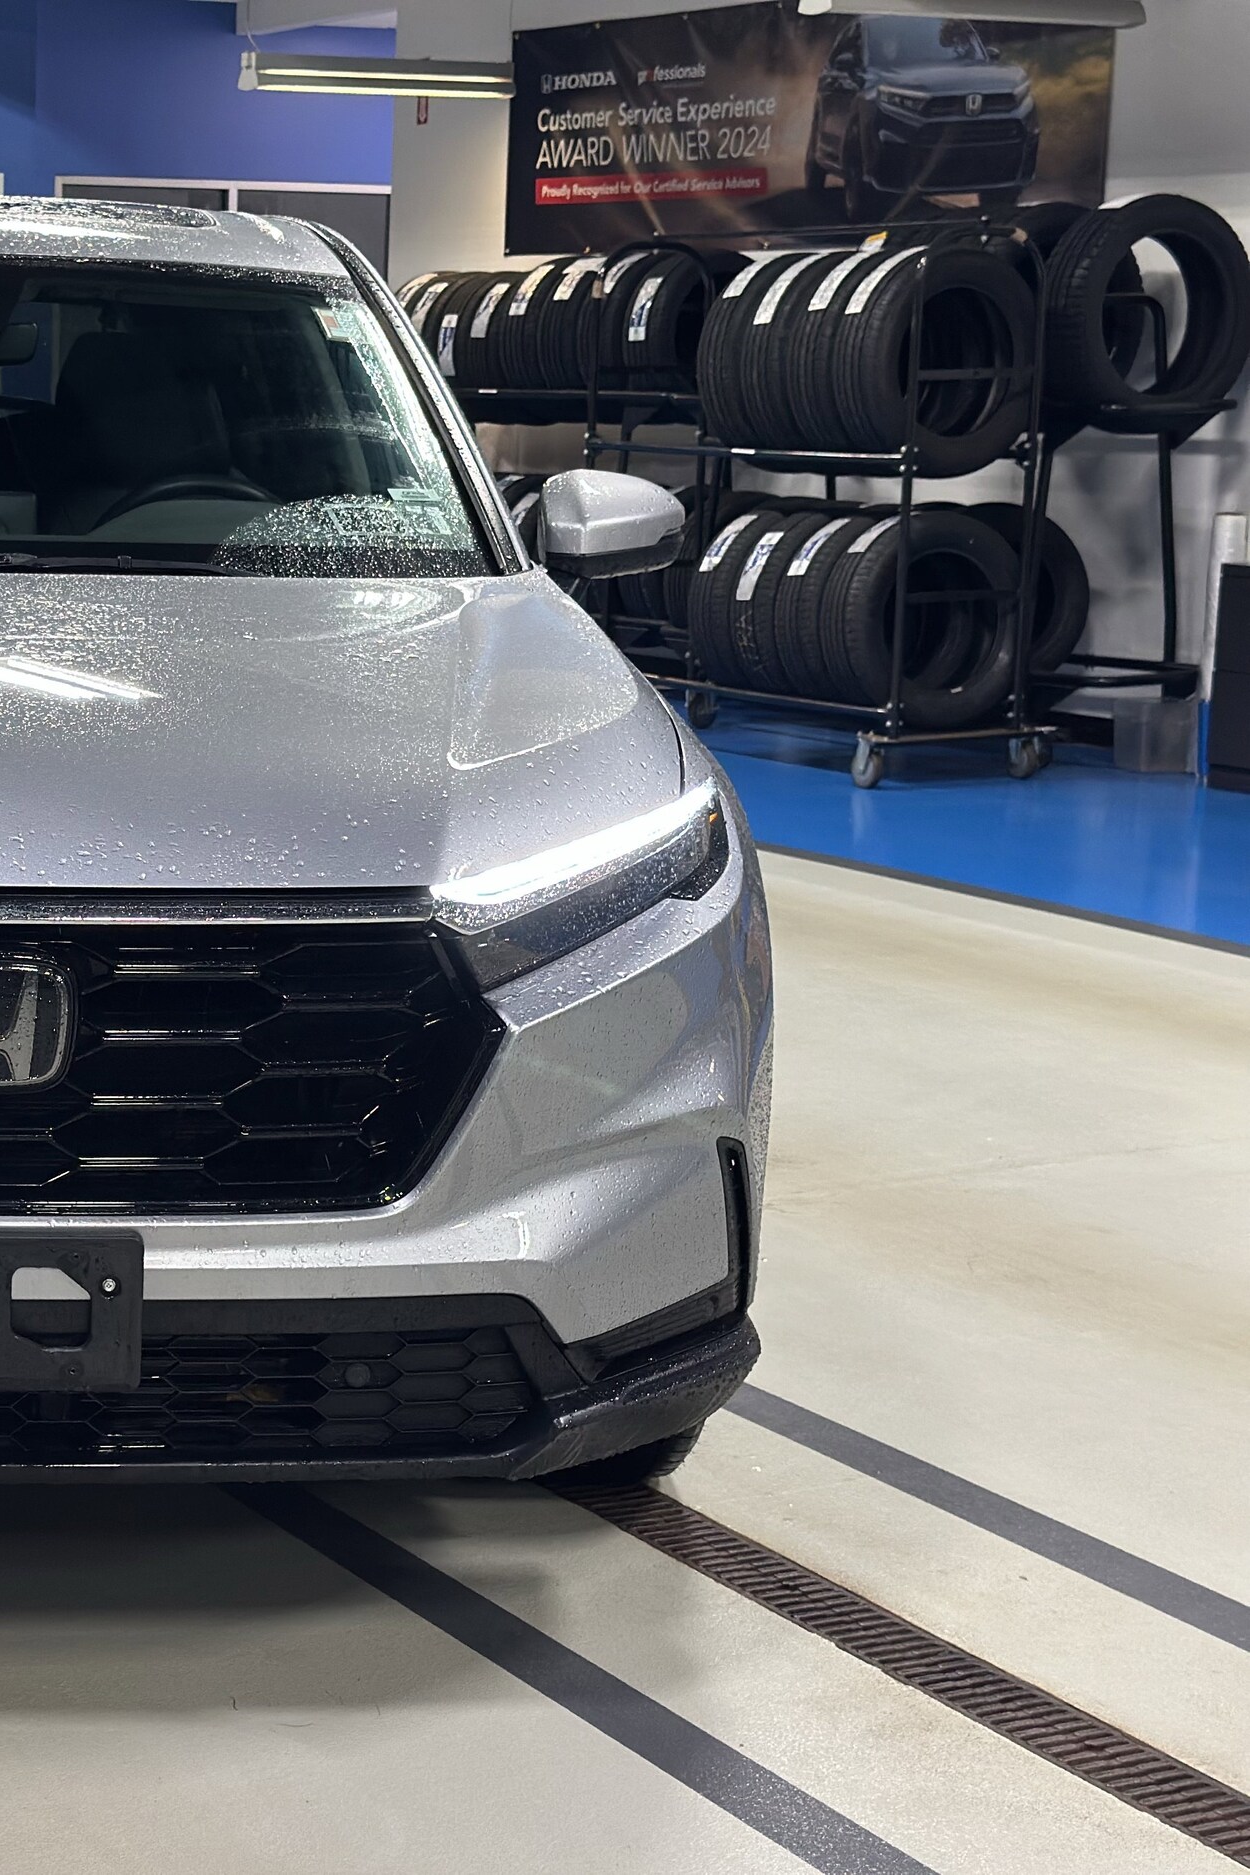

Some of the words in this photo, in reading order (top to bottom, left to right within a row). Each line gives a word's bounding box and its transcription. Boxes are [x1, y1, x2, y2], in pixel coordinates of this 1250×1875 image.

[553, 71, 617, 91] HONDA
[537, 107, 613, 132] Customer
[618, 101, 673, 127] Service
[677, 94, 776, 126] Experience
[535, 137, 614, 170] AWARD
[622, 132, 712, 166] WINNER
[717, 125, 771, 160] 2024
[633, 179, 652, 194] Our
